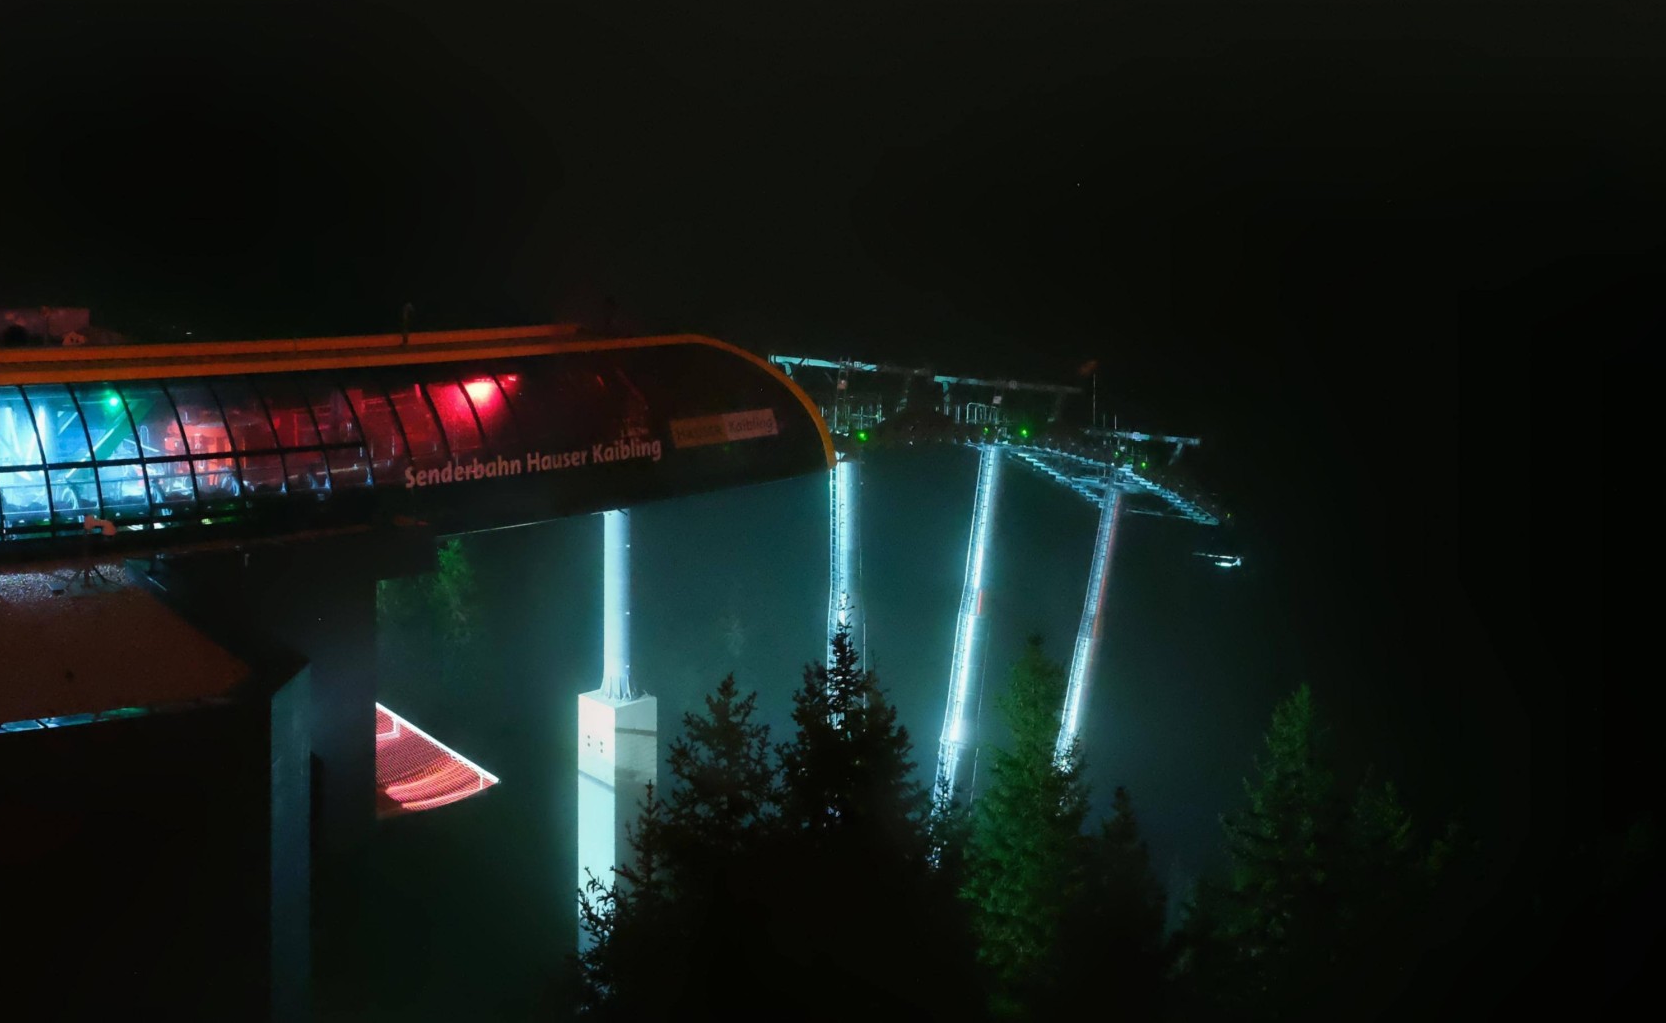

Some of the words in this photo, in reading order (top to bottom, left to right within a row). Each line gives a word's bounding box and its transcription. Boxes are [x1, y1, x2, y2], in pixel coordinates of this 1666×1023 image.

[404, 454, 522, 489] Senderbahn
[526, 448, 588, 474] Hauser
[592, 438, 662, 464] Kaibling
